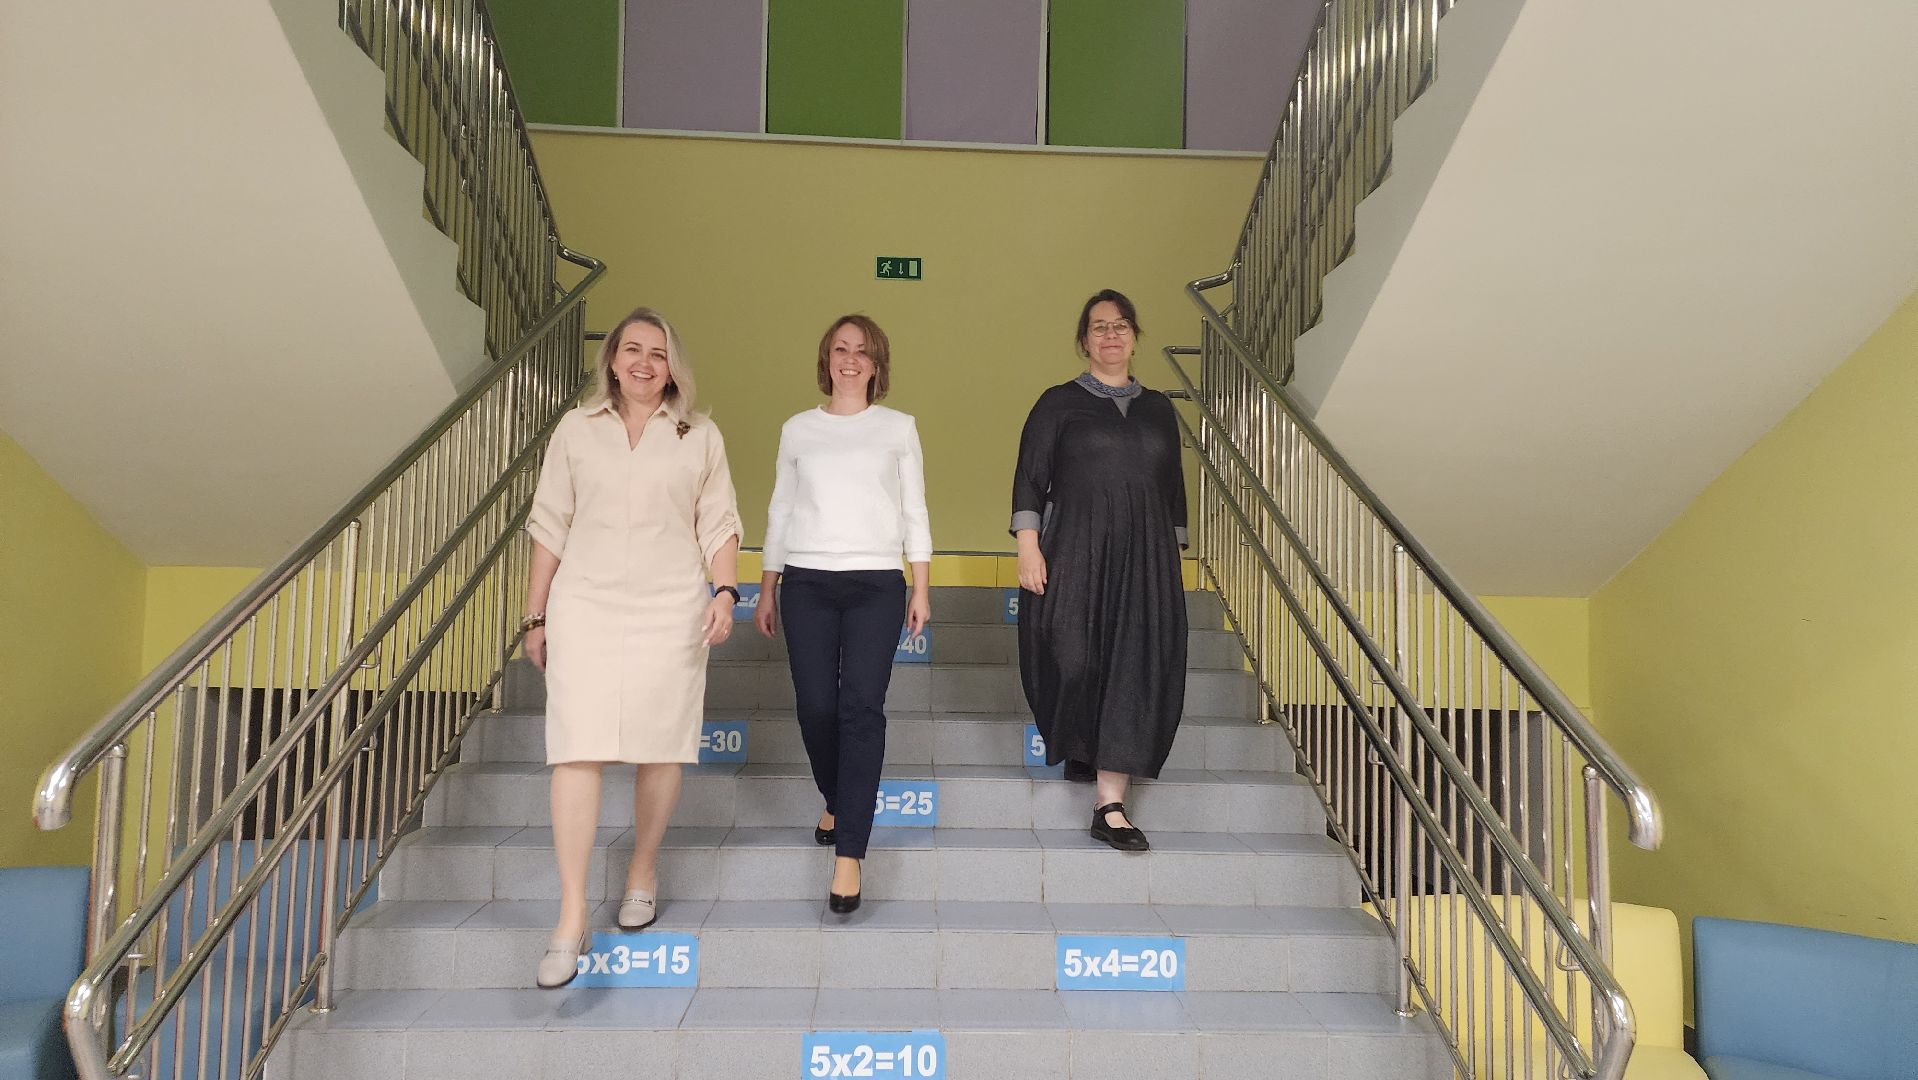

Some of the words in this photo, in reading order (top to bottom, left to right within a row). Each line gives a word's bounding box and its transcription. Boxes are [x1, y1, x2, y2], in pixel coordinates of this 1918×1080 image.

[1030, 734, 1046, 757] 5
[1064, 948, 1178, 979] 5x4=20
[810, 1044, 937, 1078] 5x2=10
